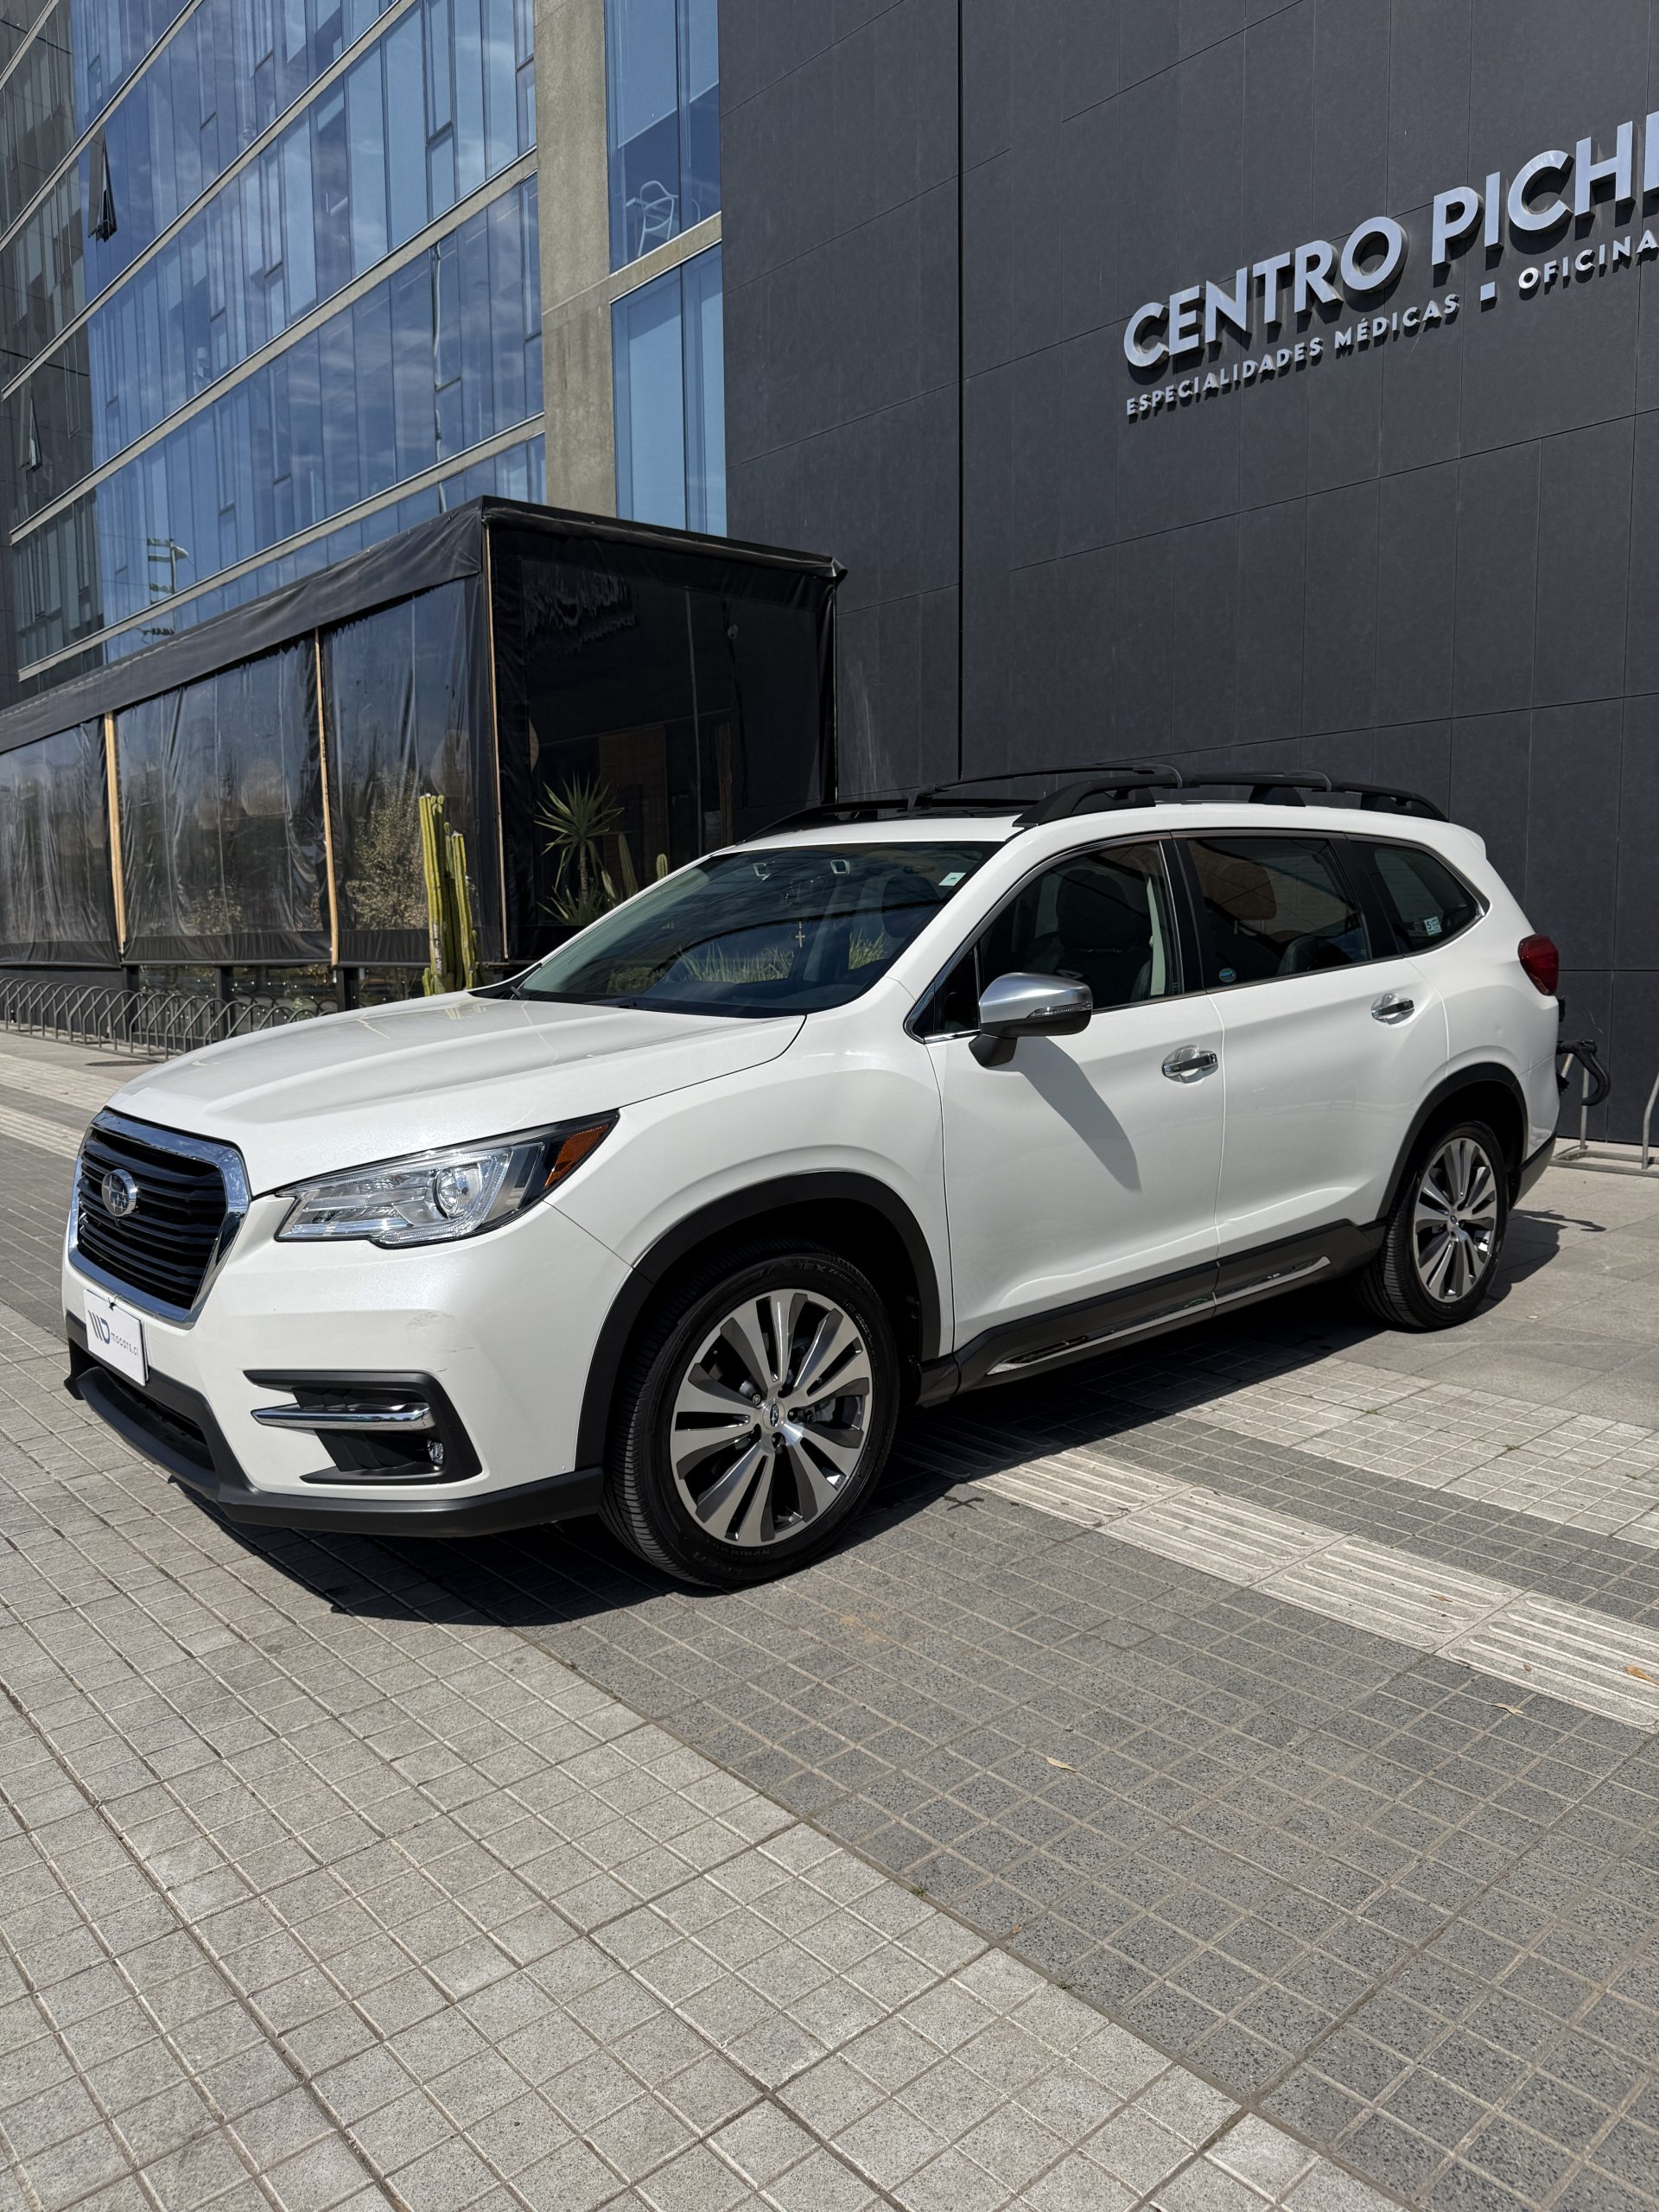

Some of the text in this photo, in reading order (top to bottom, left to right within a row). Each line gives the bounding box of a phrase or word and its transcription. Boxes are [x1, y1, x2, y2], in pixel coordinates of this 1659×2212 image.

[1123, 216, 1408, 368] CENTRO
[1126, 337, 1324, 417] ESPECIALIDADES
[1335, 294, 1459, 349] MÉDICAS
